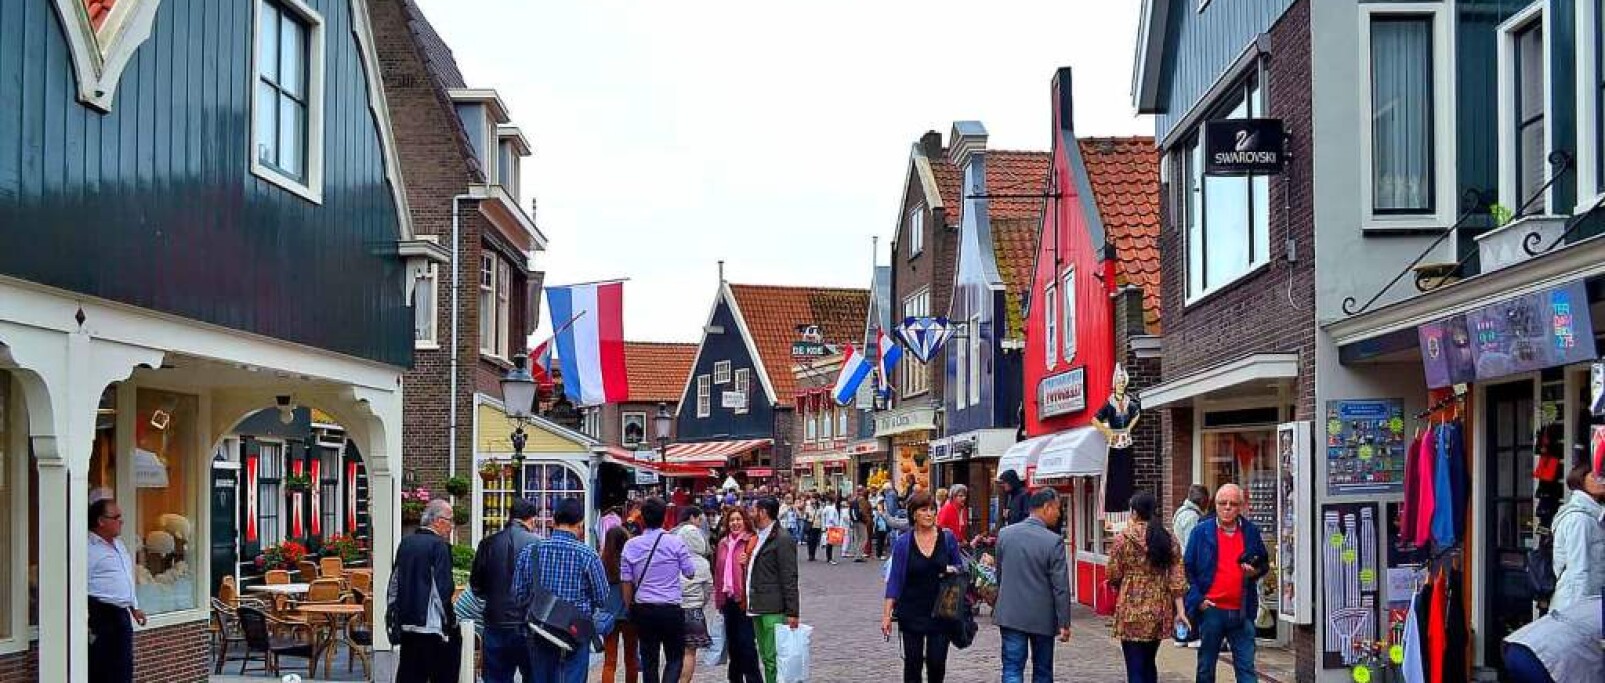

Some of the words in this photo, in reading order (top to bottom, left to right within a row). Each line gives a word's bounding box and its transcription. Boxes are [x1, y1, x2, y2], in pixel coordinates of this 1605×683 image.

[1215, 152, 1277, 164] SWAROVSKI
[792, 345, 805, 355] DE
[806, 345, 824, 355] KOE
